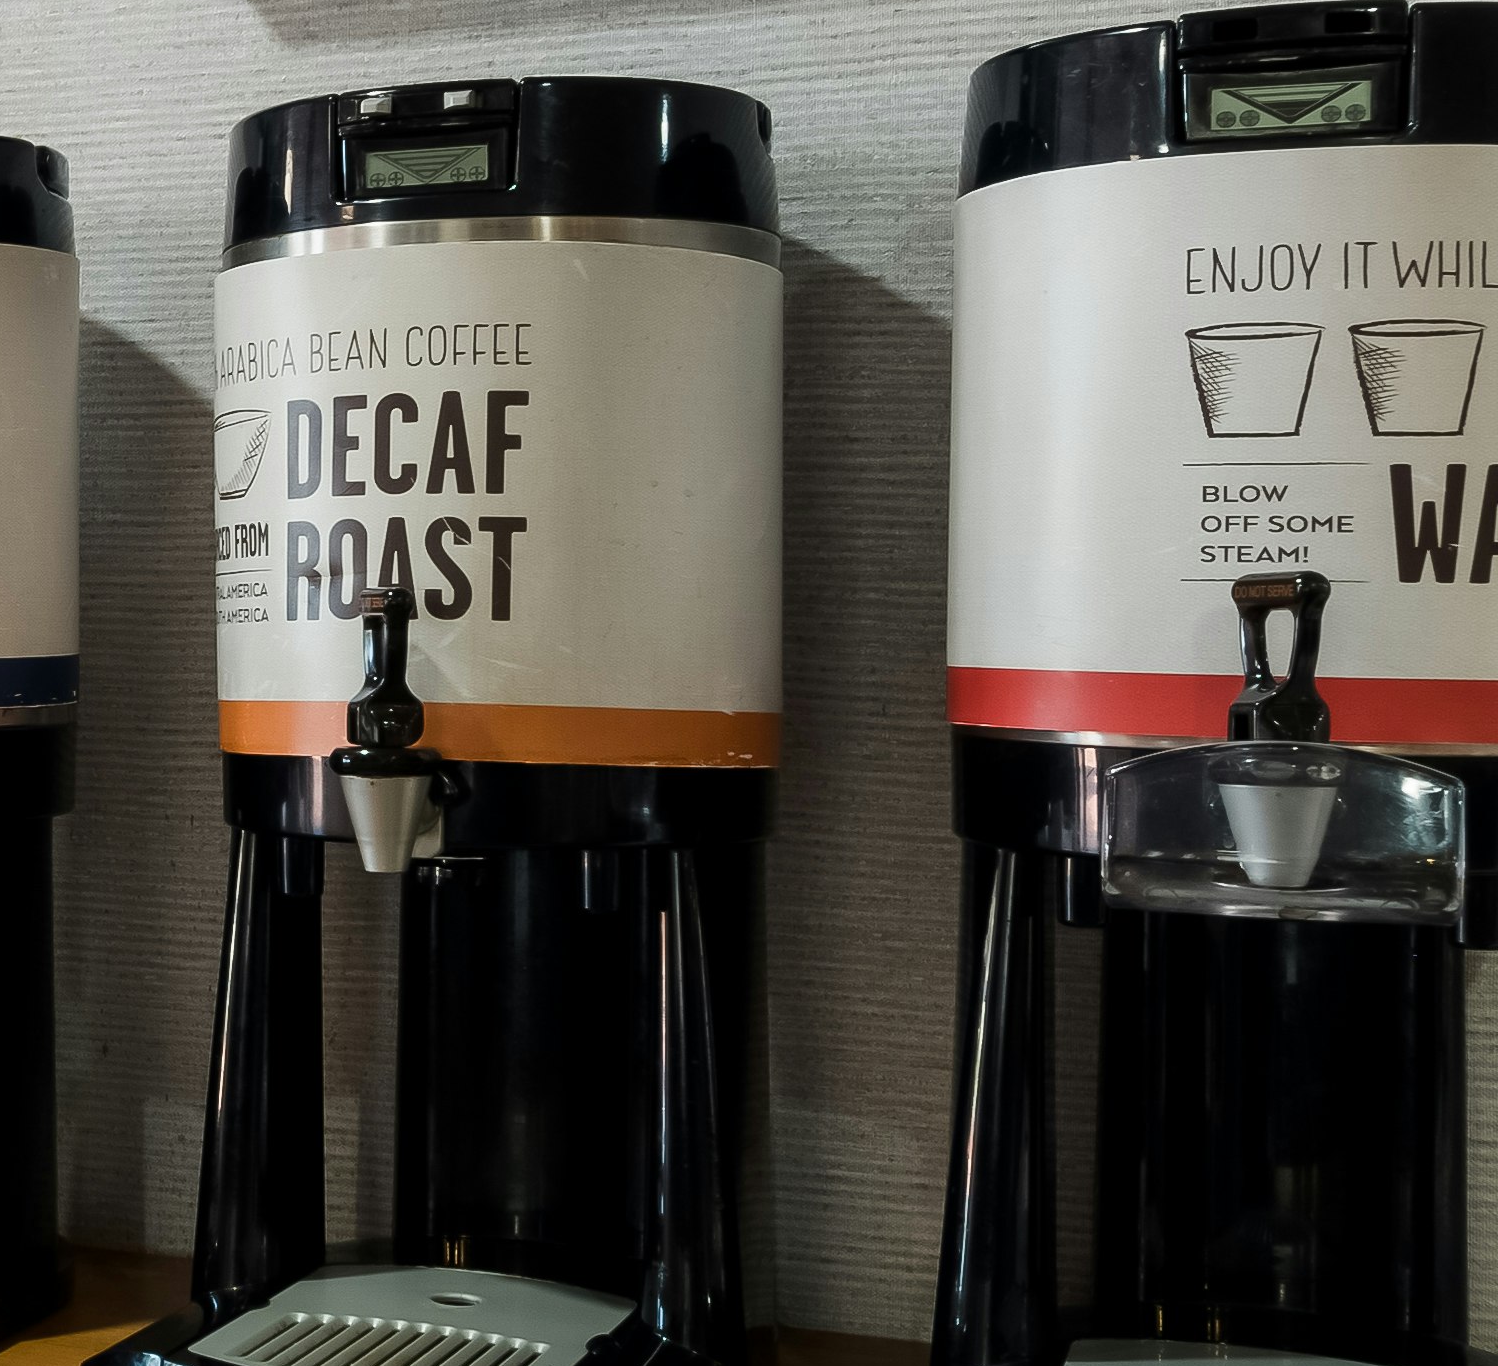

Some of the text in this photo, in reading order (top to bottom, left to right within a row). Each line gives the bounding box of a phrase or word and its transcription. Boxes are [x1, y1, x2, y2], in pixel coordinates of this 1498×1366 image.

[1186, 243, 1322, 295] ENJOY
[1344, 241, 1379, 289] IT
[218, 337, 297, 387] ARABICA
[309, 327, 388, 374] BEAN
[405, 323, 533, 366] COFFEE
[286, 390, 530, 500] DECAF
[1202, 485, 1289, 503] BLOW
[234, 521, 269, 559] FROM
[1200, 515, 1355, 533] OFF SOME
[286, 517, 528, 622] ROAST
[1200, 545, 1309, 563] STEAM!
[1234, 587, 1247, 599] DO
[1268, 585, 1294, 596] SERVE
